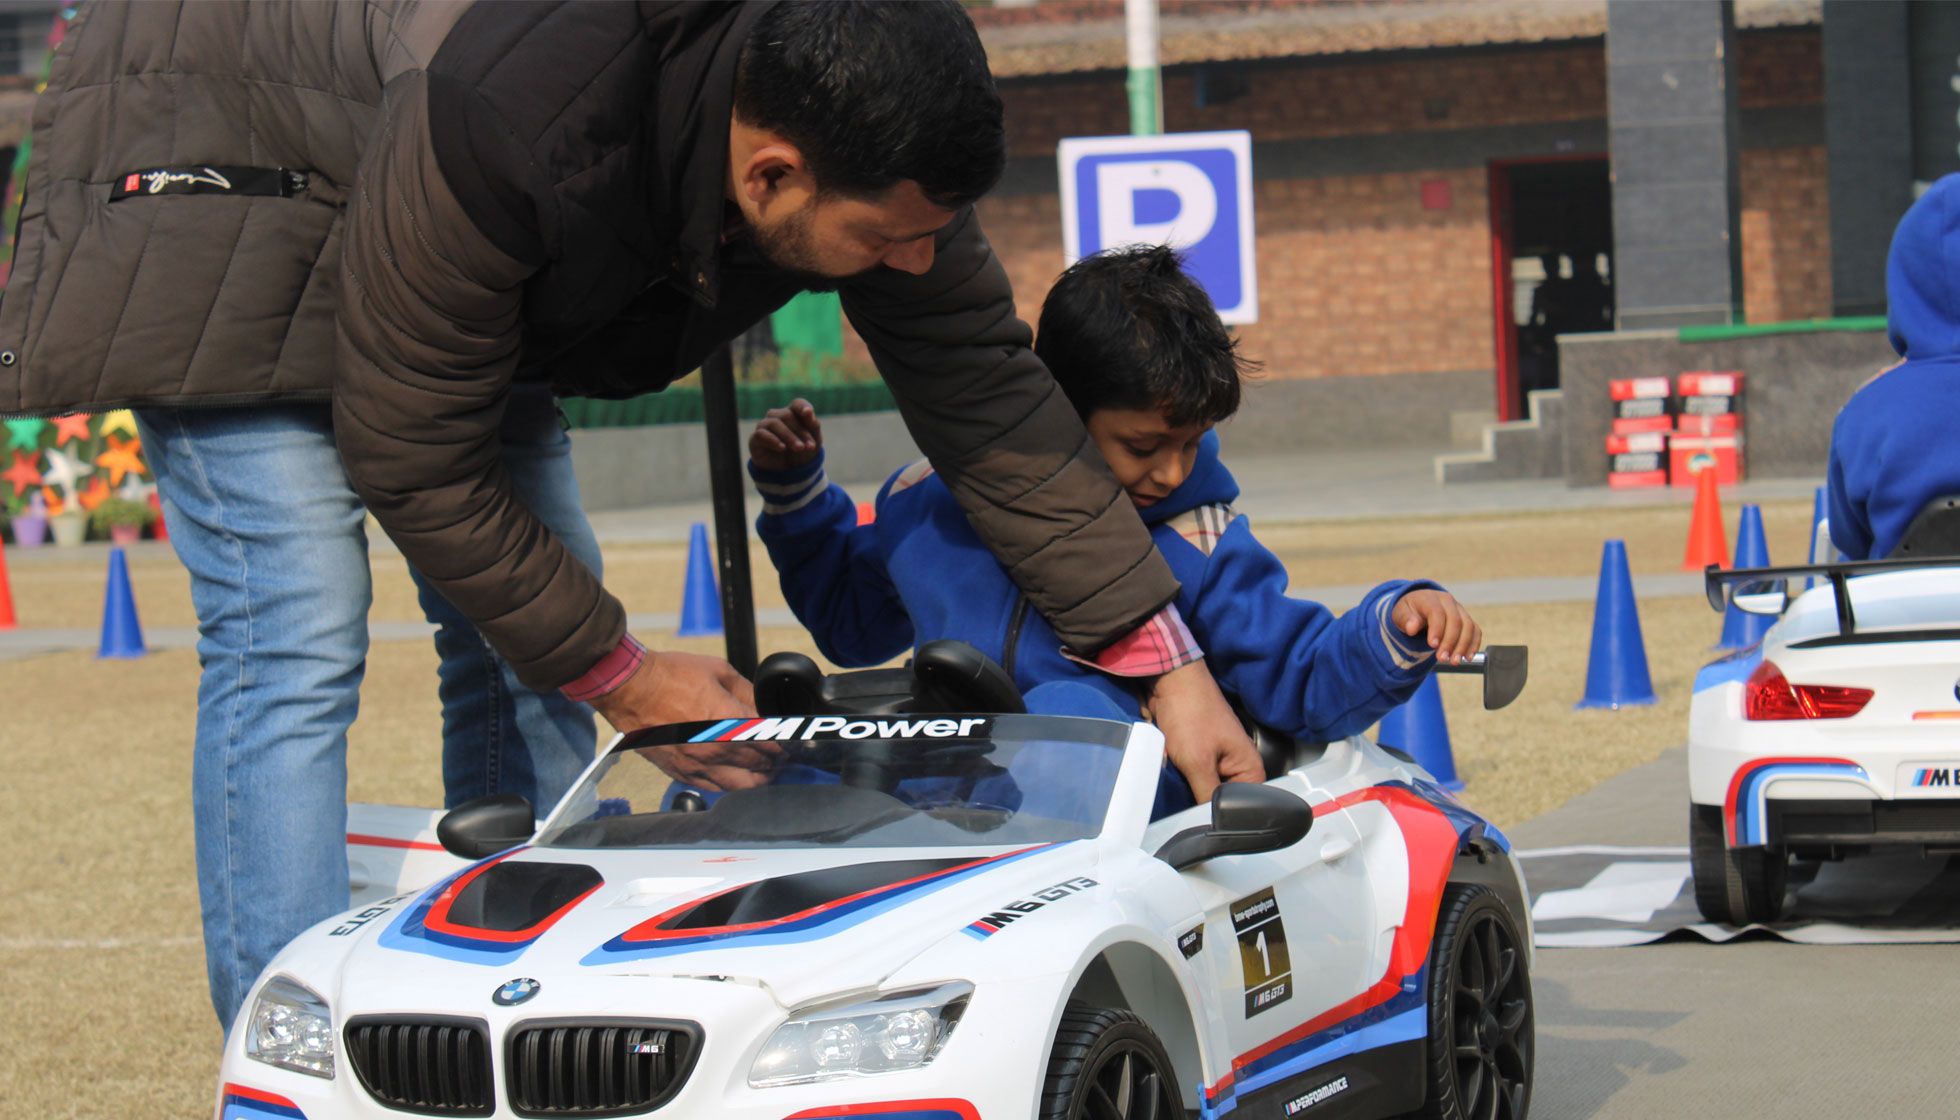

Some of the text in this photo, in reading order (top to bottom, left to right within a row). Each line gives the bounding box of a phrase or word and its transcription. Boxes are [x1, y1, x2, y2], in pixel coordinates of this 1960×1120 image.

[1097, 160, 1218, 258] P
[328, 907, 391, 936] GT3
[980, 876, 1100, 929] M6 GT3
[1255, 930, 1271, 977] 1
